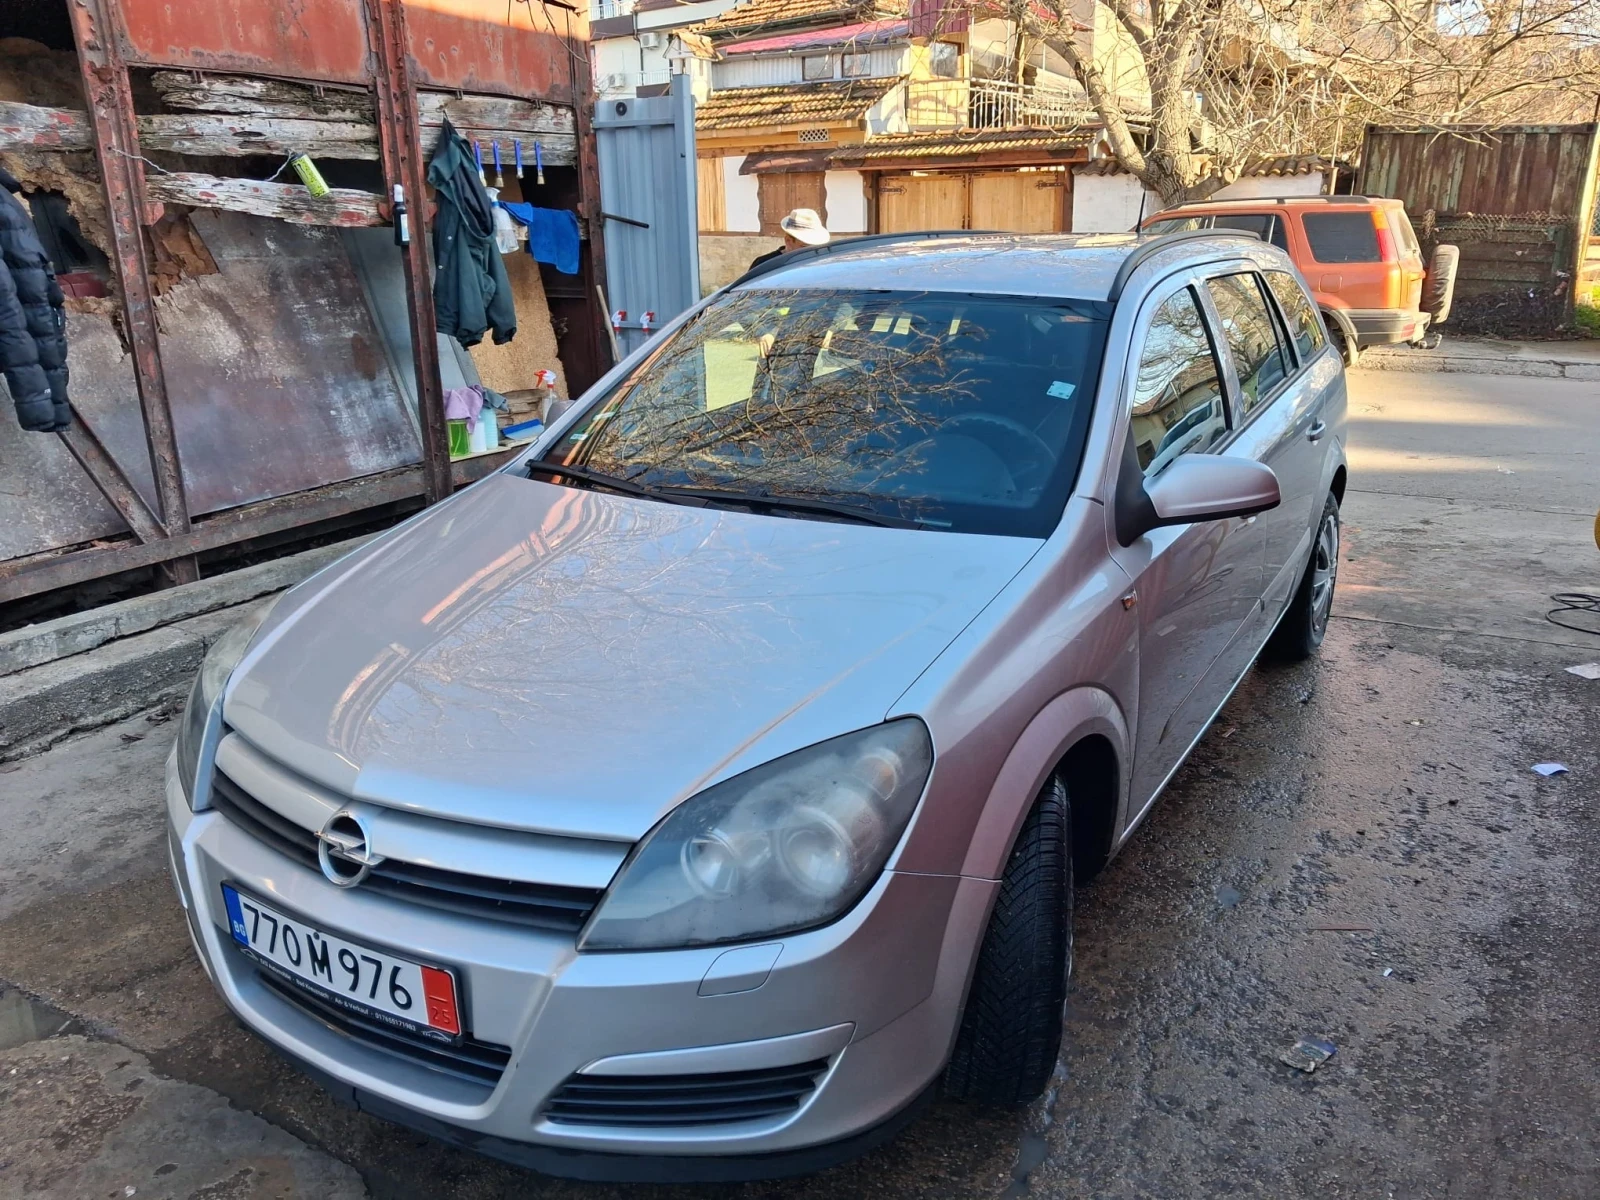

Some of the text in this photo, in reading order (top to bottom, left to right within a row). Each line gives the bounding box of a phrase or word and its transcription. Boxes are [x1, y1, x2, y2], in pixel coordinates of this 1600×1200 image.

[233, 920, 247, 937] BG
[243, 902, 413, 1010] 770 M 976
[432, 1006, 451, 1025] 25
